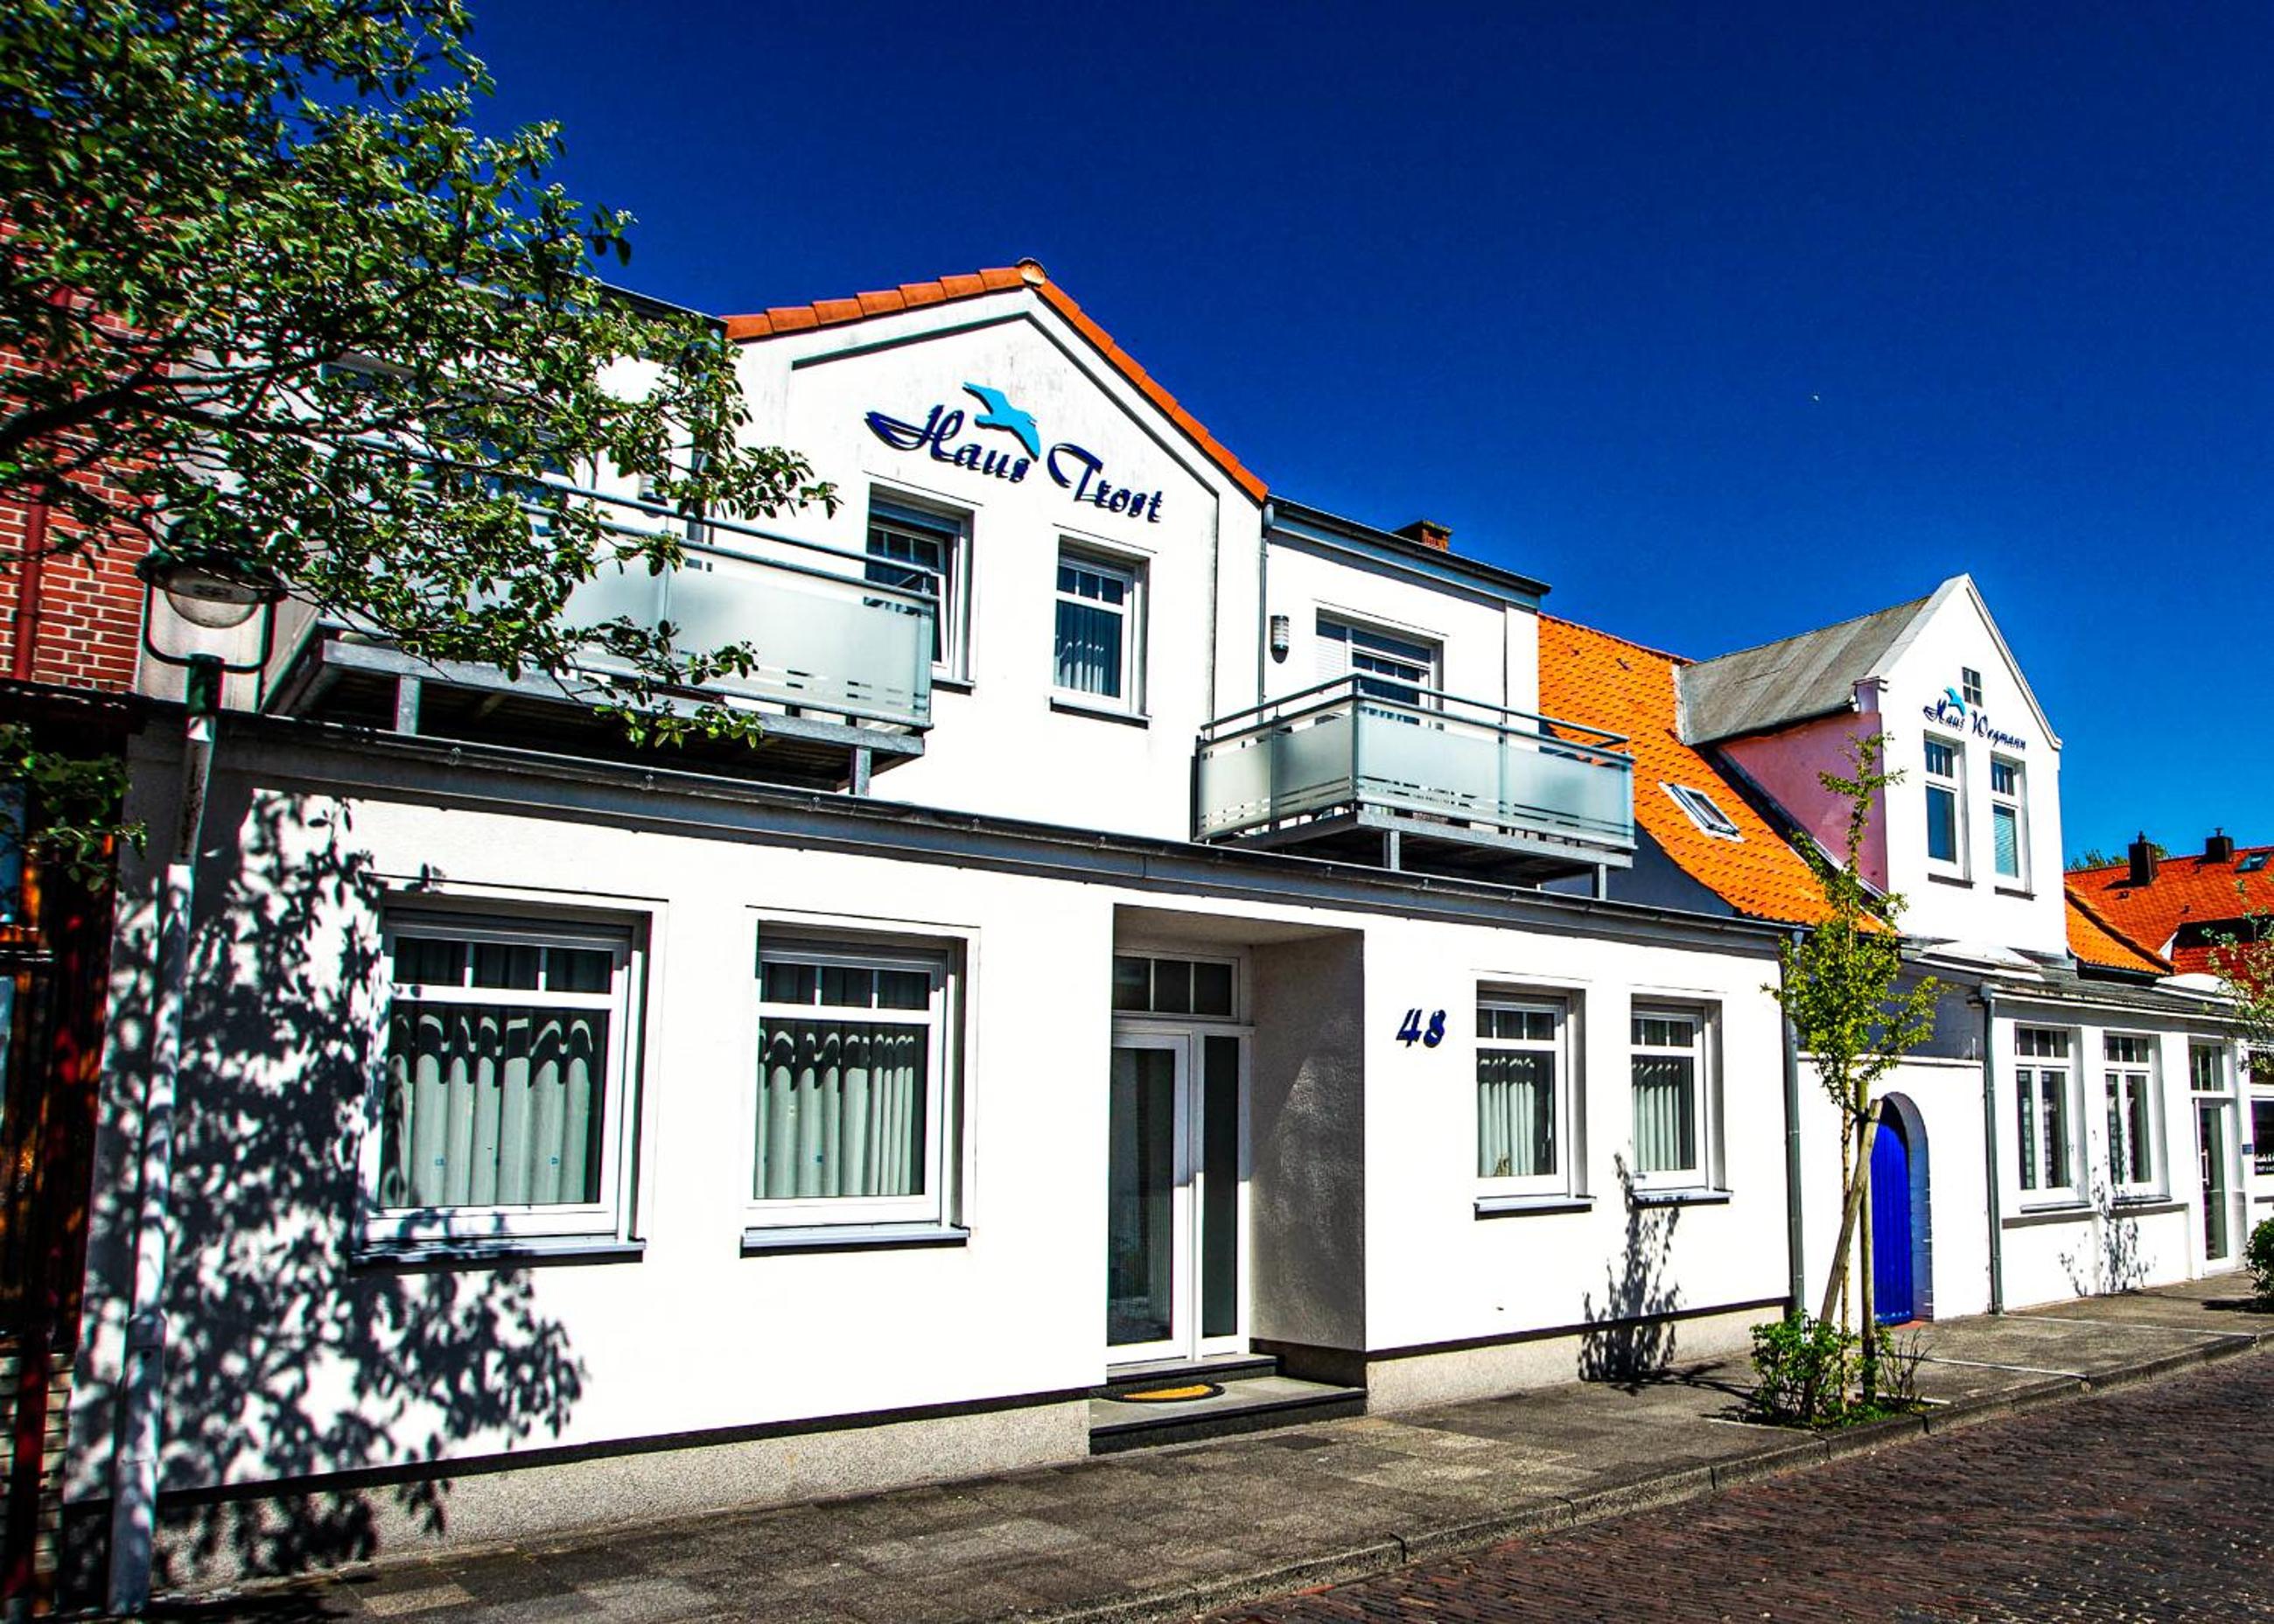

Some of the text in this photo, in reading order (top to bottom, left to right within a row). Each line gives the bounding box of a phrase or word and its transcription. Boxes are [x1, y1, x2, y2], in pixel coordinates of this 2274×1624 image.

[864, 404, 1163, 523] Haus Trost
[1922, 698, 1965, 732] Haus
[1396, 1008, 1446, 1048] 48
